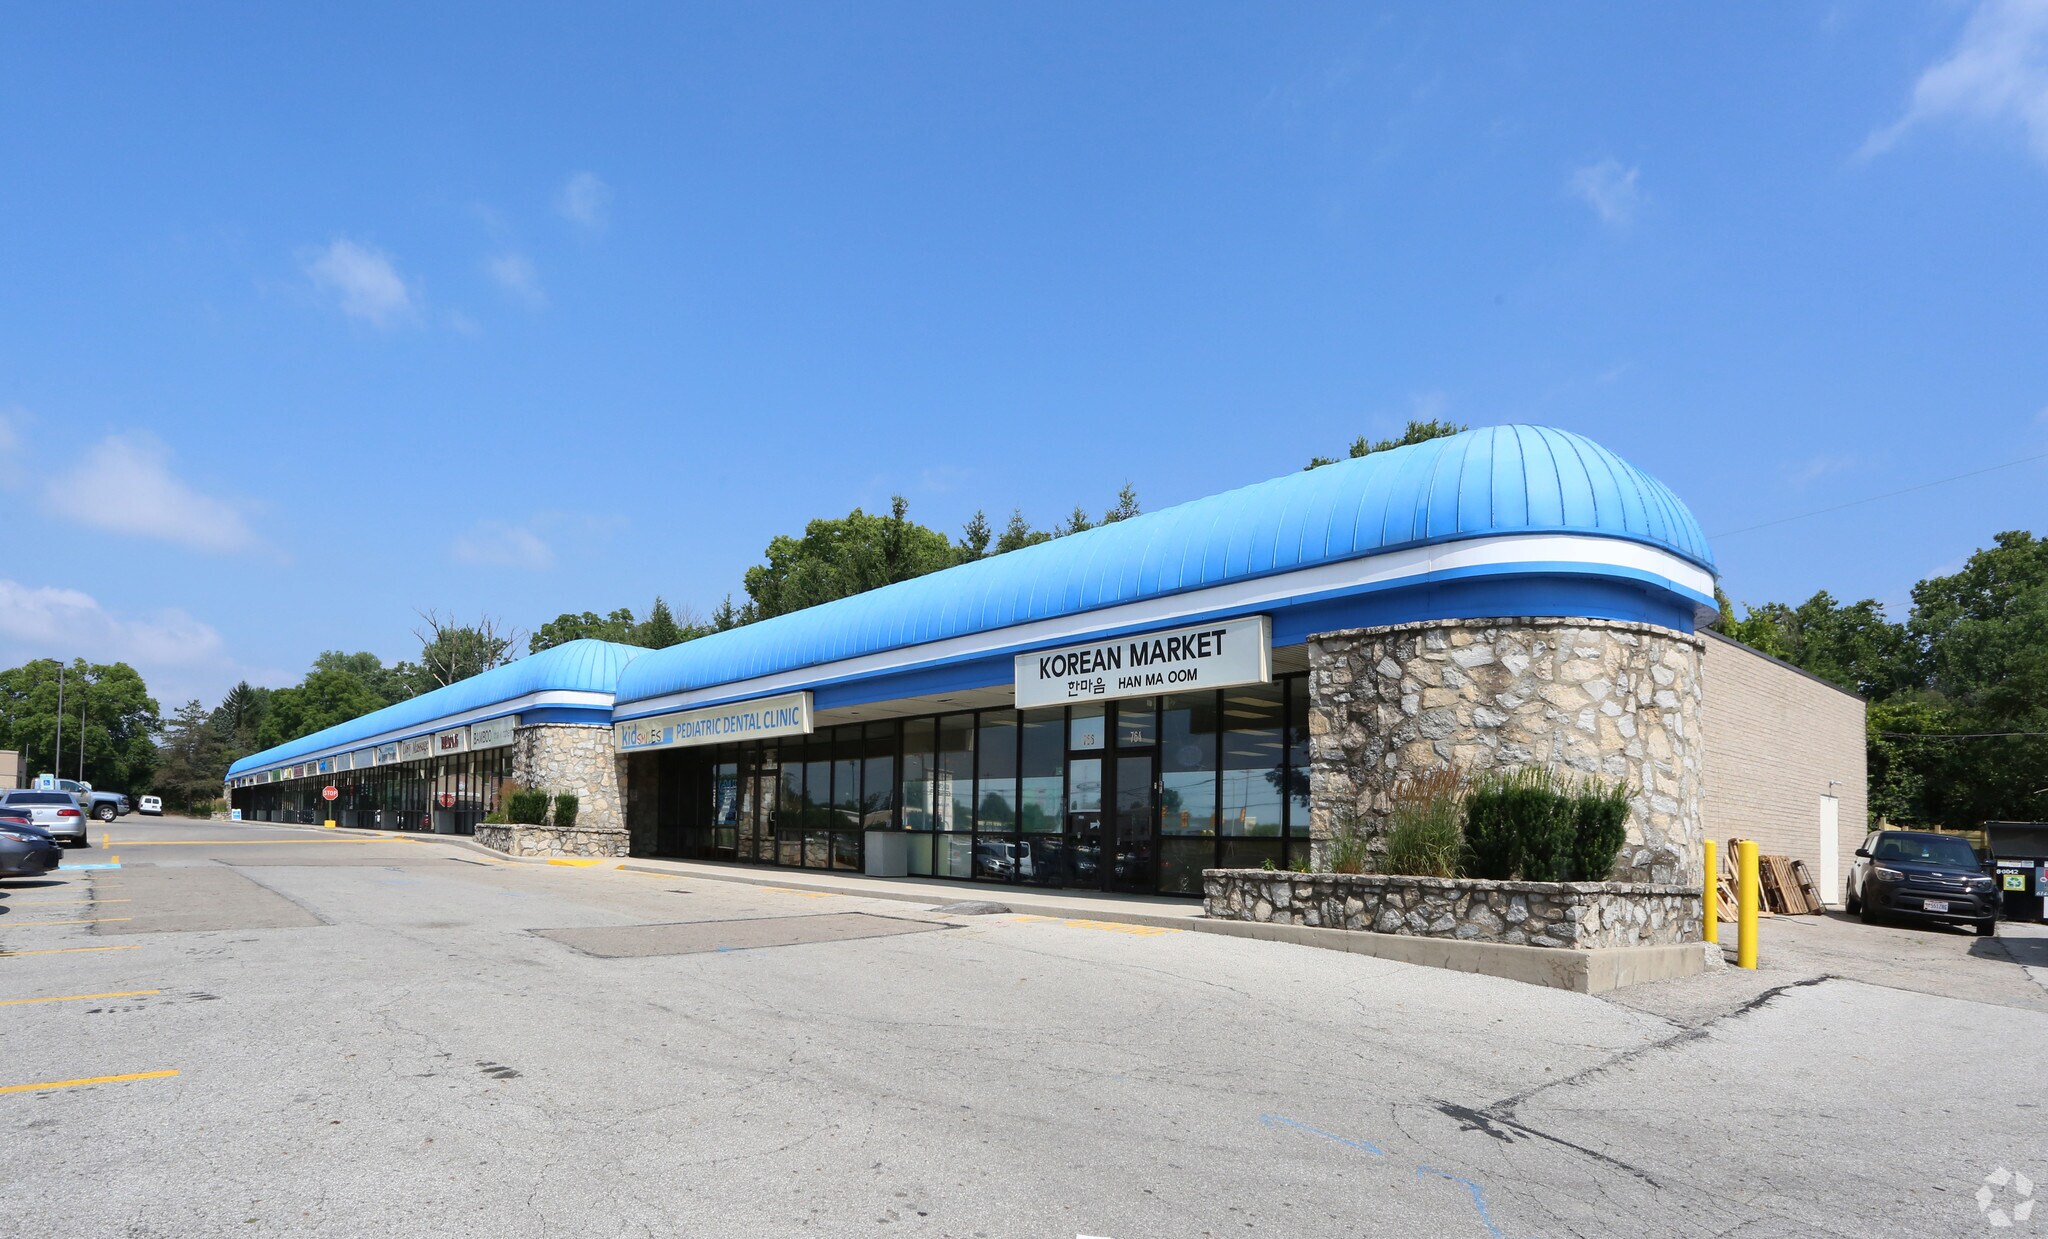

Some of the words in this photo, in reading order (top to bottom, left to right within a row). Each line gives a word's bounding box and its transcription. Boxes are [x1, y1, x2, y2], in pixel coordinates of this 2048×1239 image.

[1040, 646, 1121, 679] KOREAN
[1130, 629, 1227, 667] MARKET
[1068, 677, 1106, 697] 한마음
[1118, 675, 1142, 689] HAN
[1145, 672, 1164, 686] MA
[1168, 668, 1198, 684] OOM
[676, 718, 721, 739] PEDIATRIC
[723, 712, 762, 733] DENTAL
[763, 706, 799, 729] CLINIC
